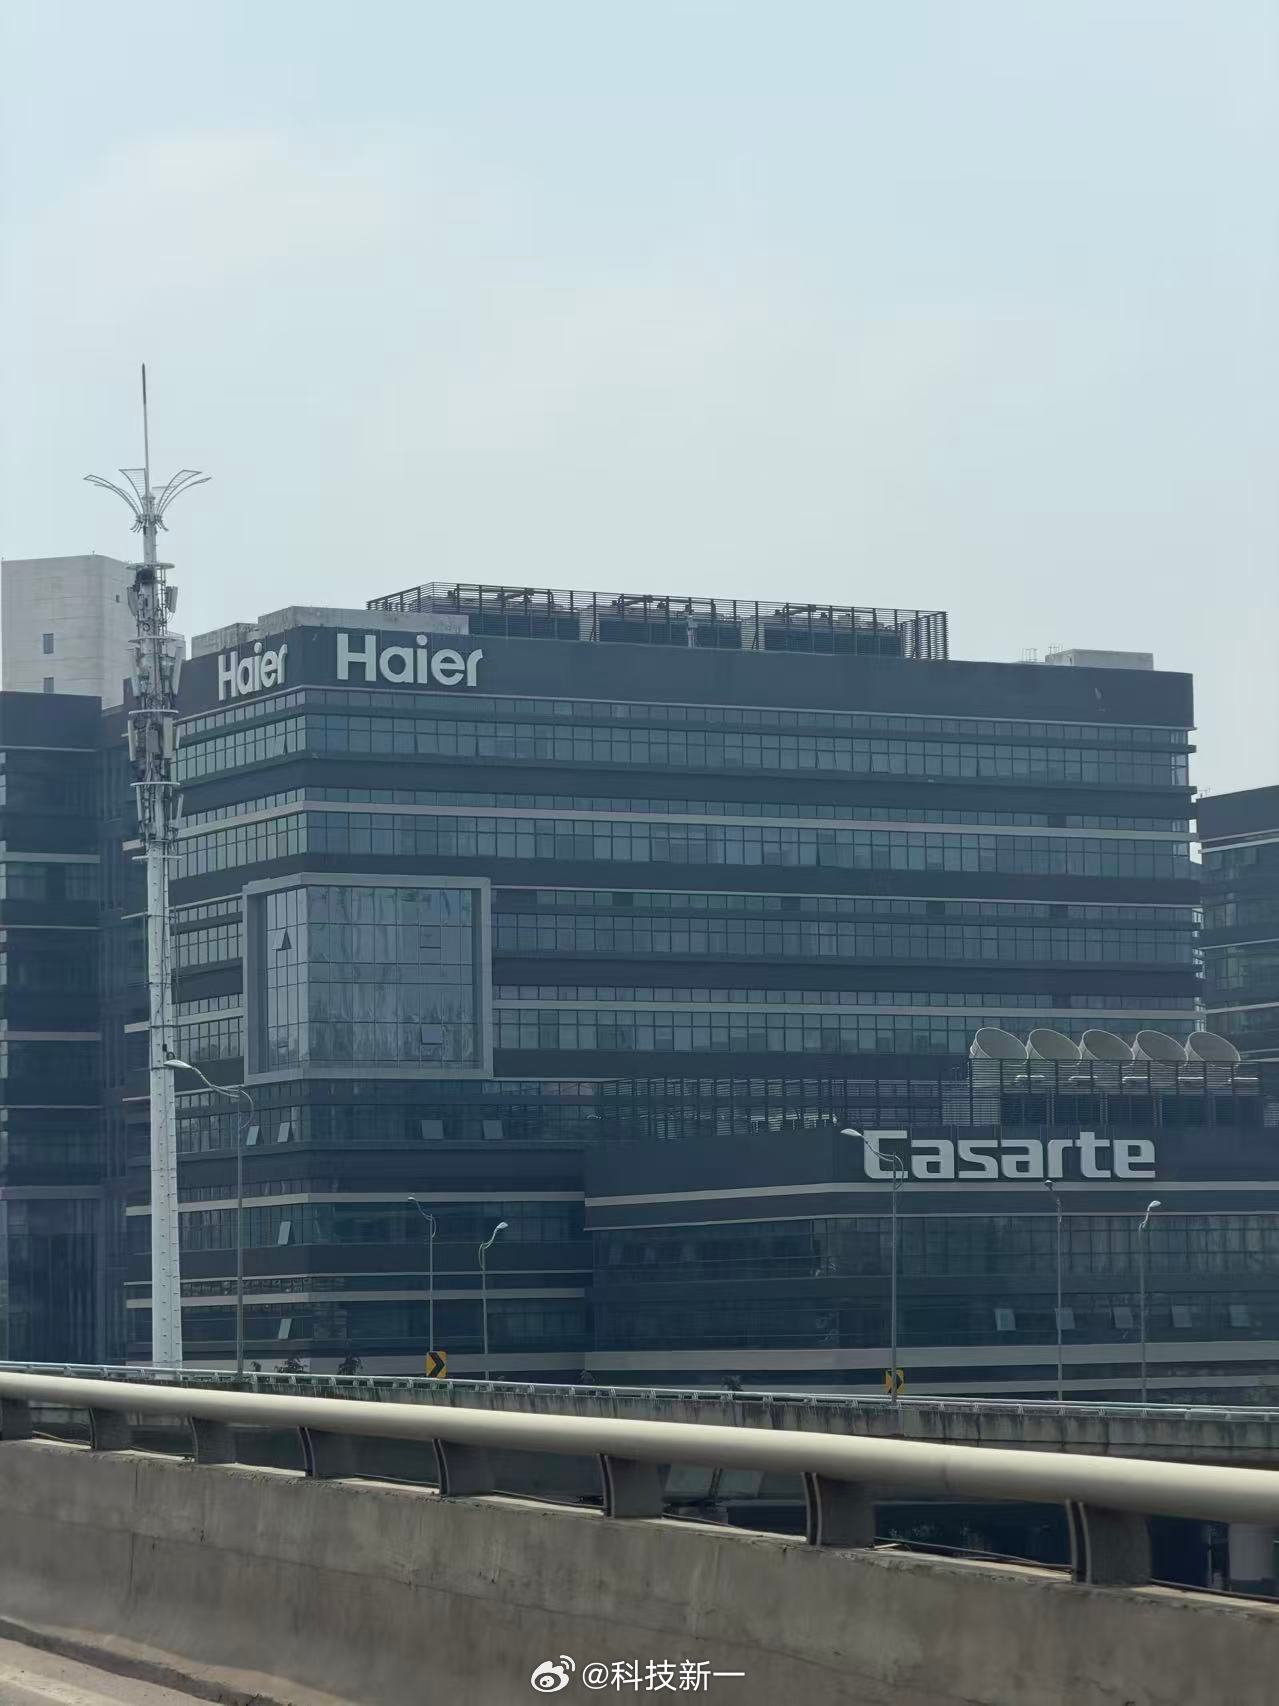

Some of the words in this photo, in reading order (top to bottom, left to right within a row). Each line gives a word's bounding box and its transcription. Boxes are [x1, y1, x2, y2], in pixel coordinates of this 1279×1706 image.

[218, 642, 288, 701] Haier
[336, 633, 484, 687] Haier
[863, 1130, 1156, 1179] Casarte
